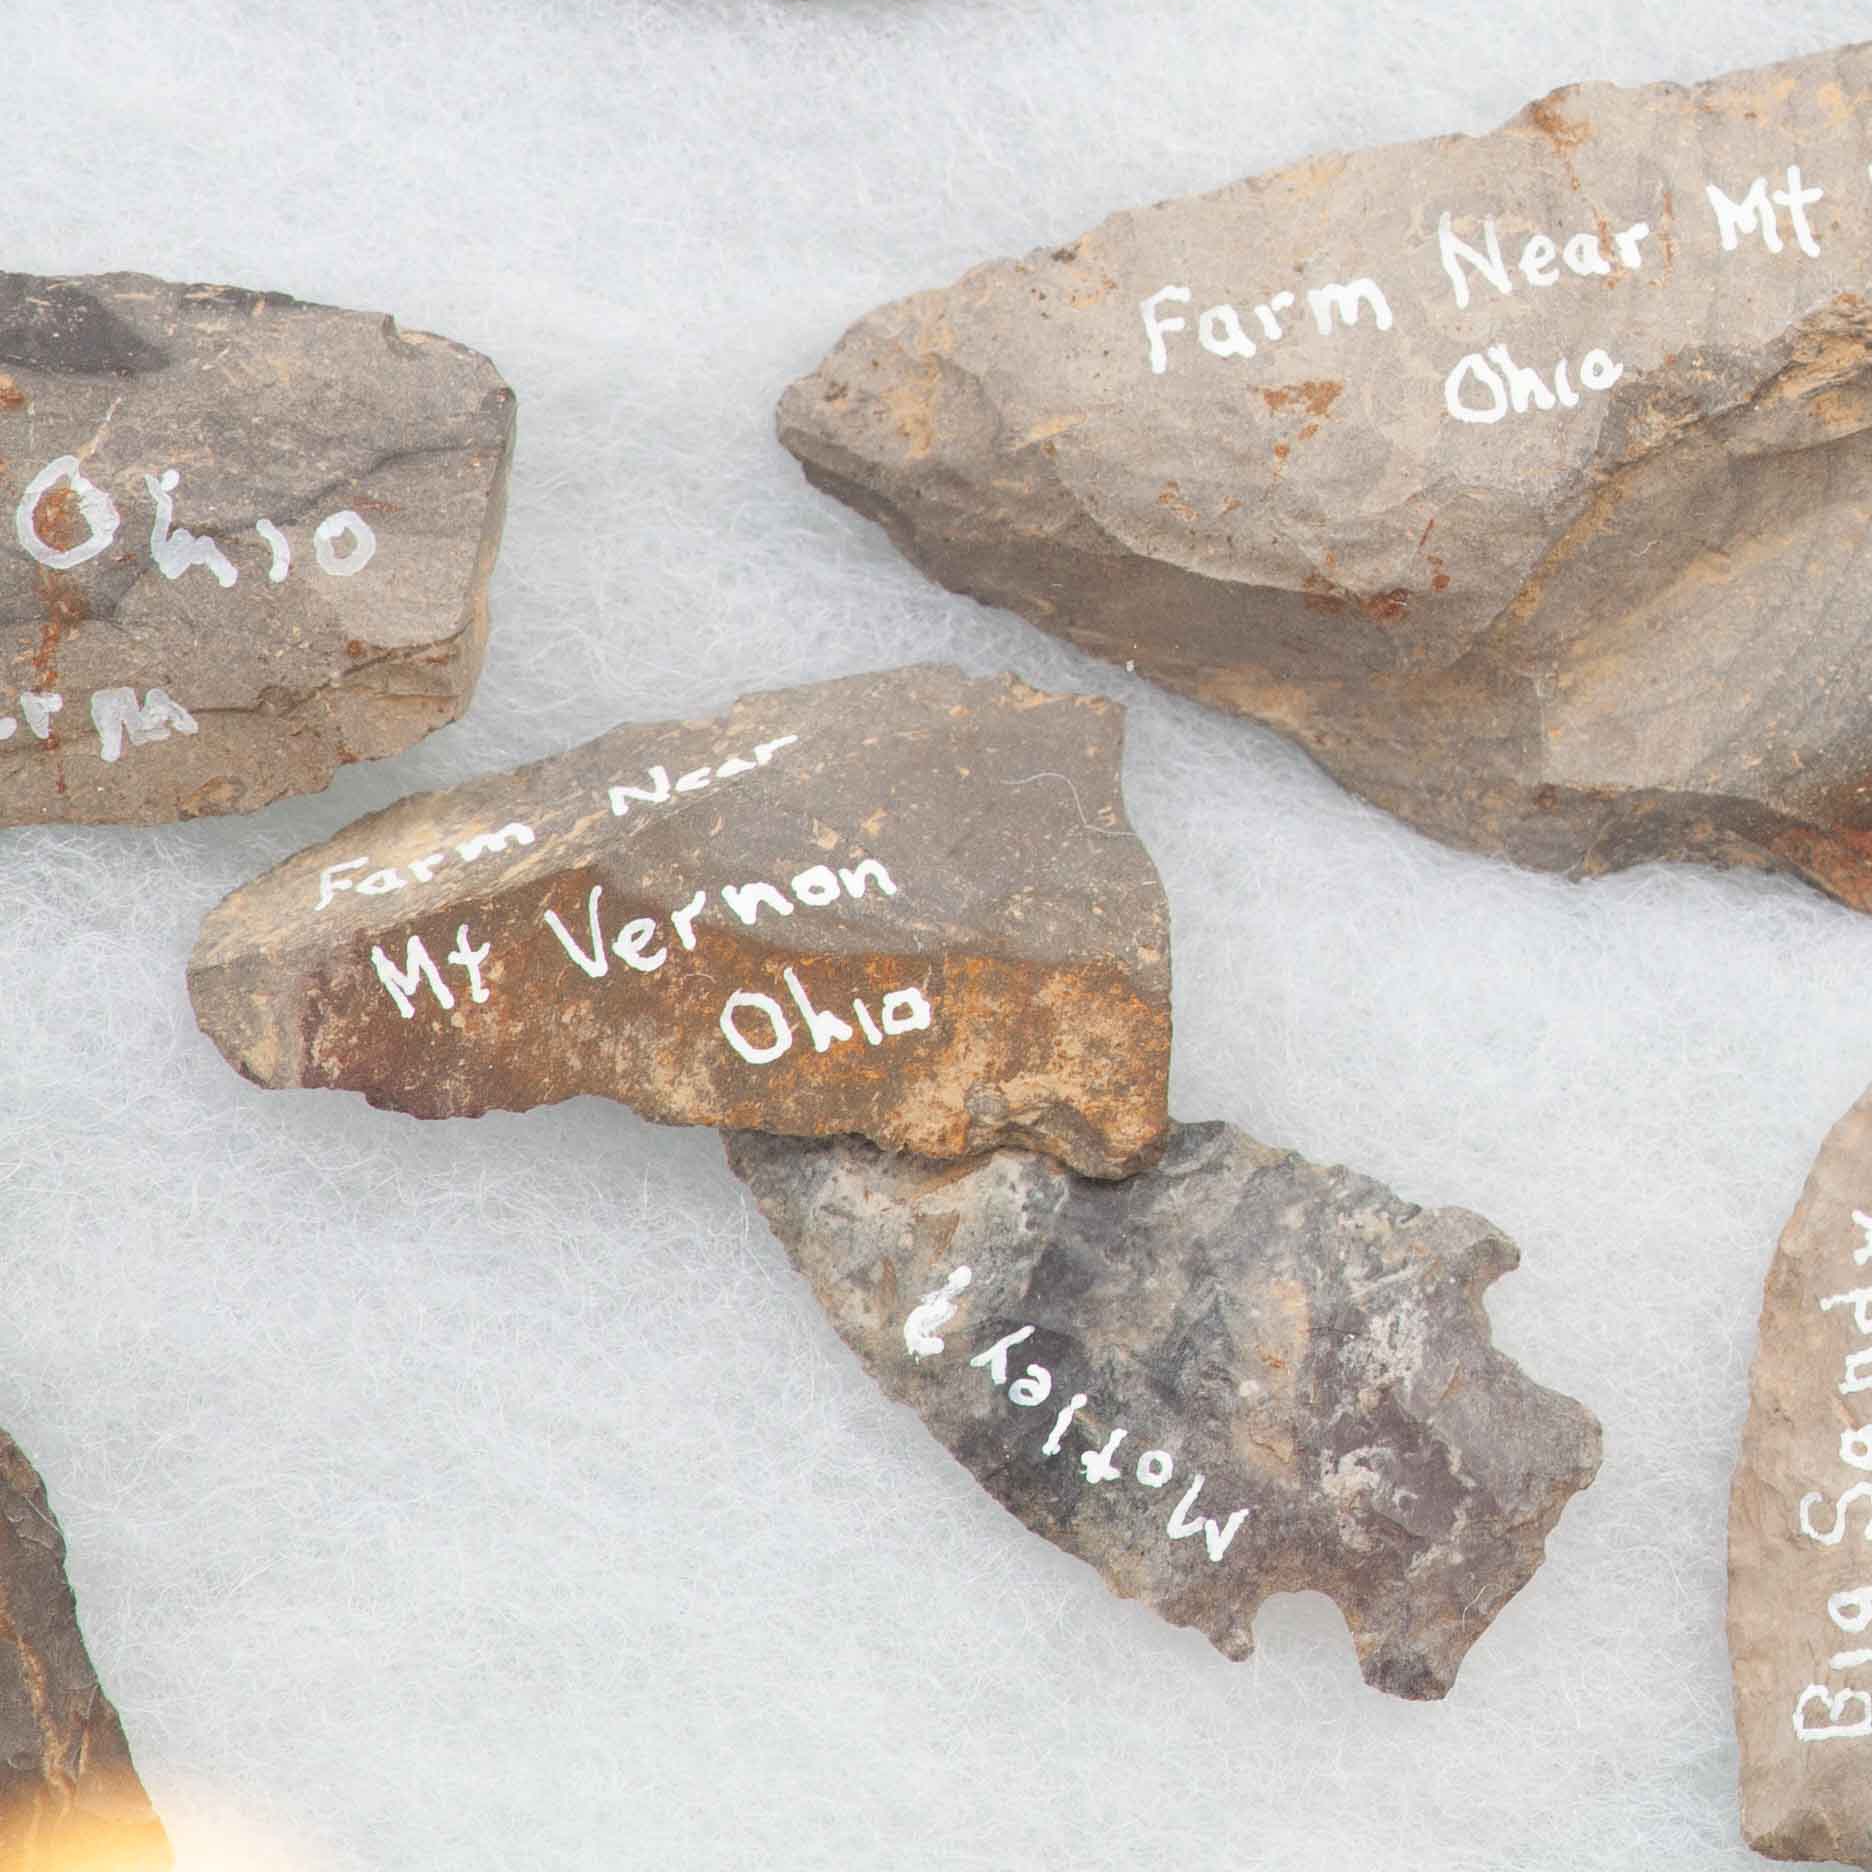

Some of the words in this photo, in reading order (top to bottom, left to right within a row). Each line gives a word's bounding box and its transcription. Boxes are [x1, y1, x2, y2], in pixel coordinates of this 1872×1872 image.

[1138, 275, 1394, 374] Farm
[1437, 213, 1650, 309] Near
[1704, 165, 1824, 258] Mt
[1443, 344, 1624, 425] Ohio
[16, 455, 377, 588] Ohio
[0, 686, 198, 762] rm
[314, 822, 535, 910] Farm
[609, 734, 798, 816] Near
[371, 924, 490, 1019] Mt
[544, 858, 897, 978] Vernon
[719, 967, 931, 1065] Ohio
[970, 1325, 1250, 1562] Motley
